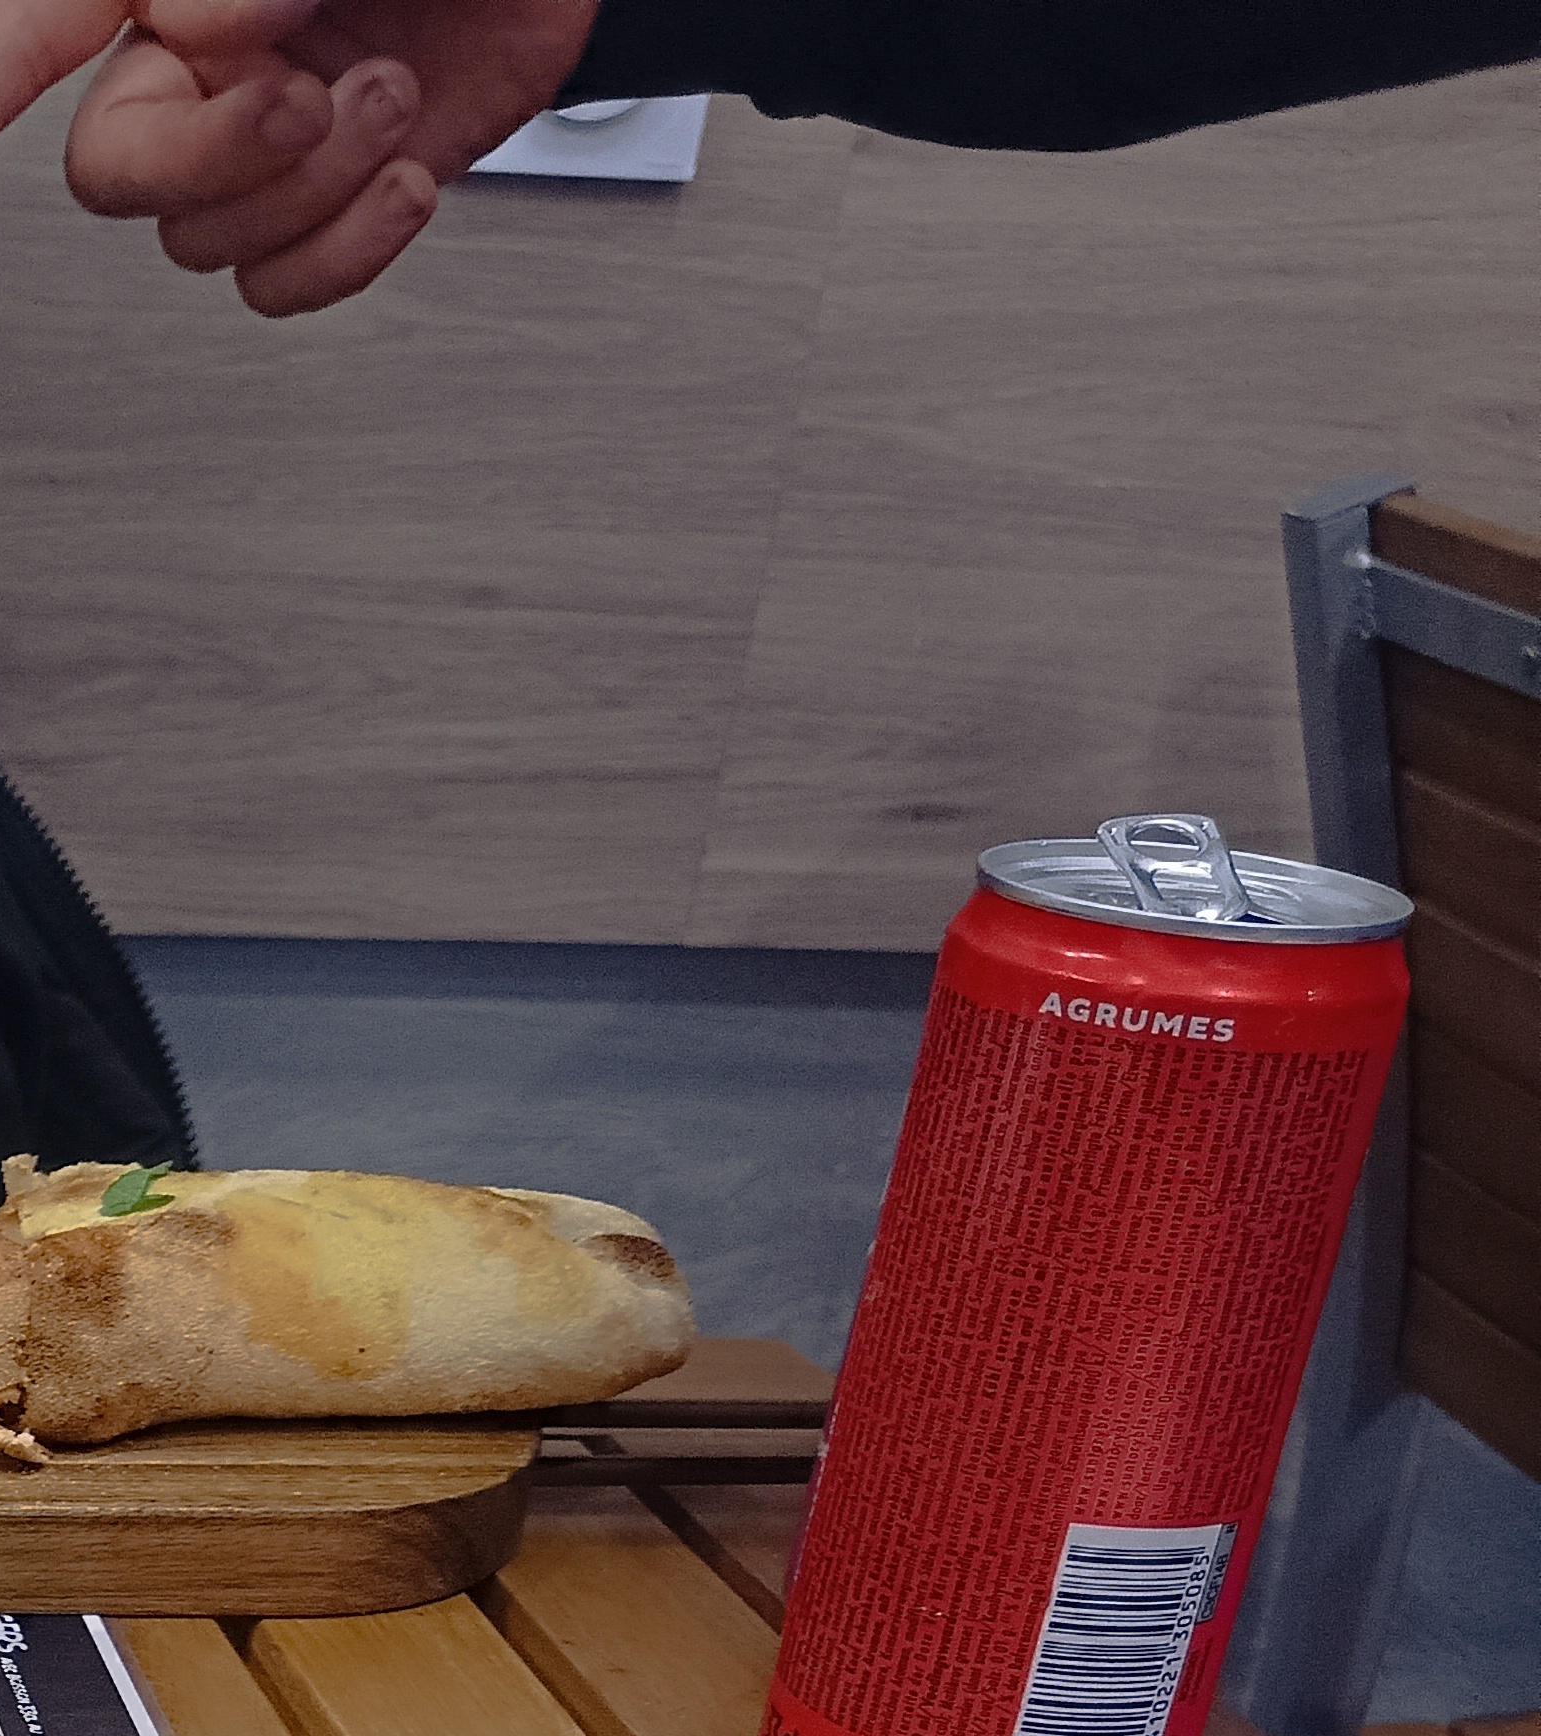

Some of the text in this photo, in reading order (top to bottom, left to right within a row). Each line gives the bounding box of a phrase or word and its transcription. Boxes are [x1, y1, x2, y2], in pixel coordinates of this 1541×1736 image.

[1038, 991, 1237, 1043] AGRUMES
[1022, 1283, 1042, 1310] 100
[1095, 1311, 1118, 1343] 2000
[1172, 1553, 1211, 1642] 305085
